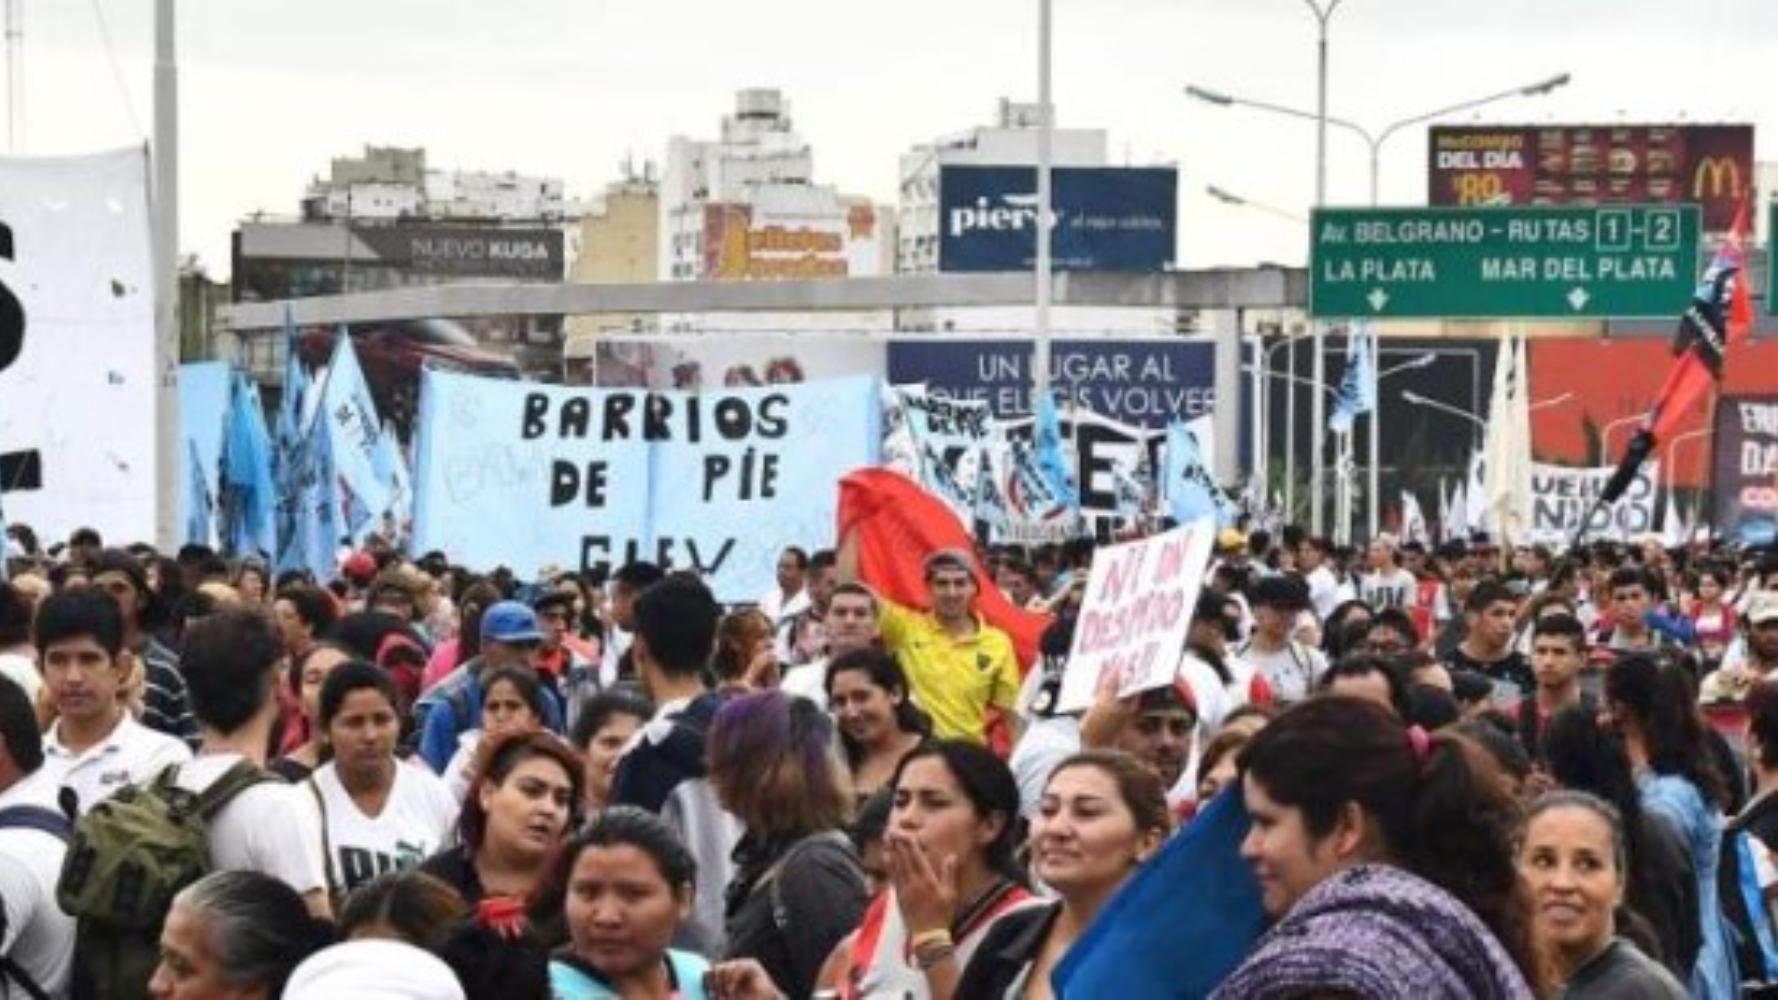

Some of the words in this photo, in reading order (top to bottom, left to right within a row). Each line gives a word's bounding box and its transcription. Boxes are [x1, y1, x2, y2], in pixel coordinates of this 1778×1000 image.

[1437, 151, 1479, 168] DEL
[1354, 219, 1484, 242] BELGRANO
[411, 237, 485, 258] NUEVO
[489, 240, 548, 259] KUGA
[1324, 260, 1355, 282] LA
[1361, 259, 1436, 282] PLATA
[1481, 257, 1536, 280] MAR
[1544, 257, 1590, 280] DEL
[1598, 257, 1675, 280] PLATA
[979, 355, 1020, 381] UN
[1030, 354, 1131, 382] UGAR
[1140, 354, 1175, 381] AL
[521, 391, 790, 443] BARRIOS
[550, 459, 608, 507] DE
